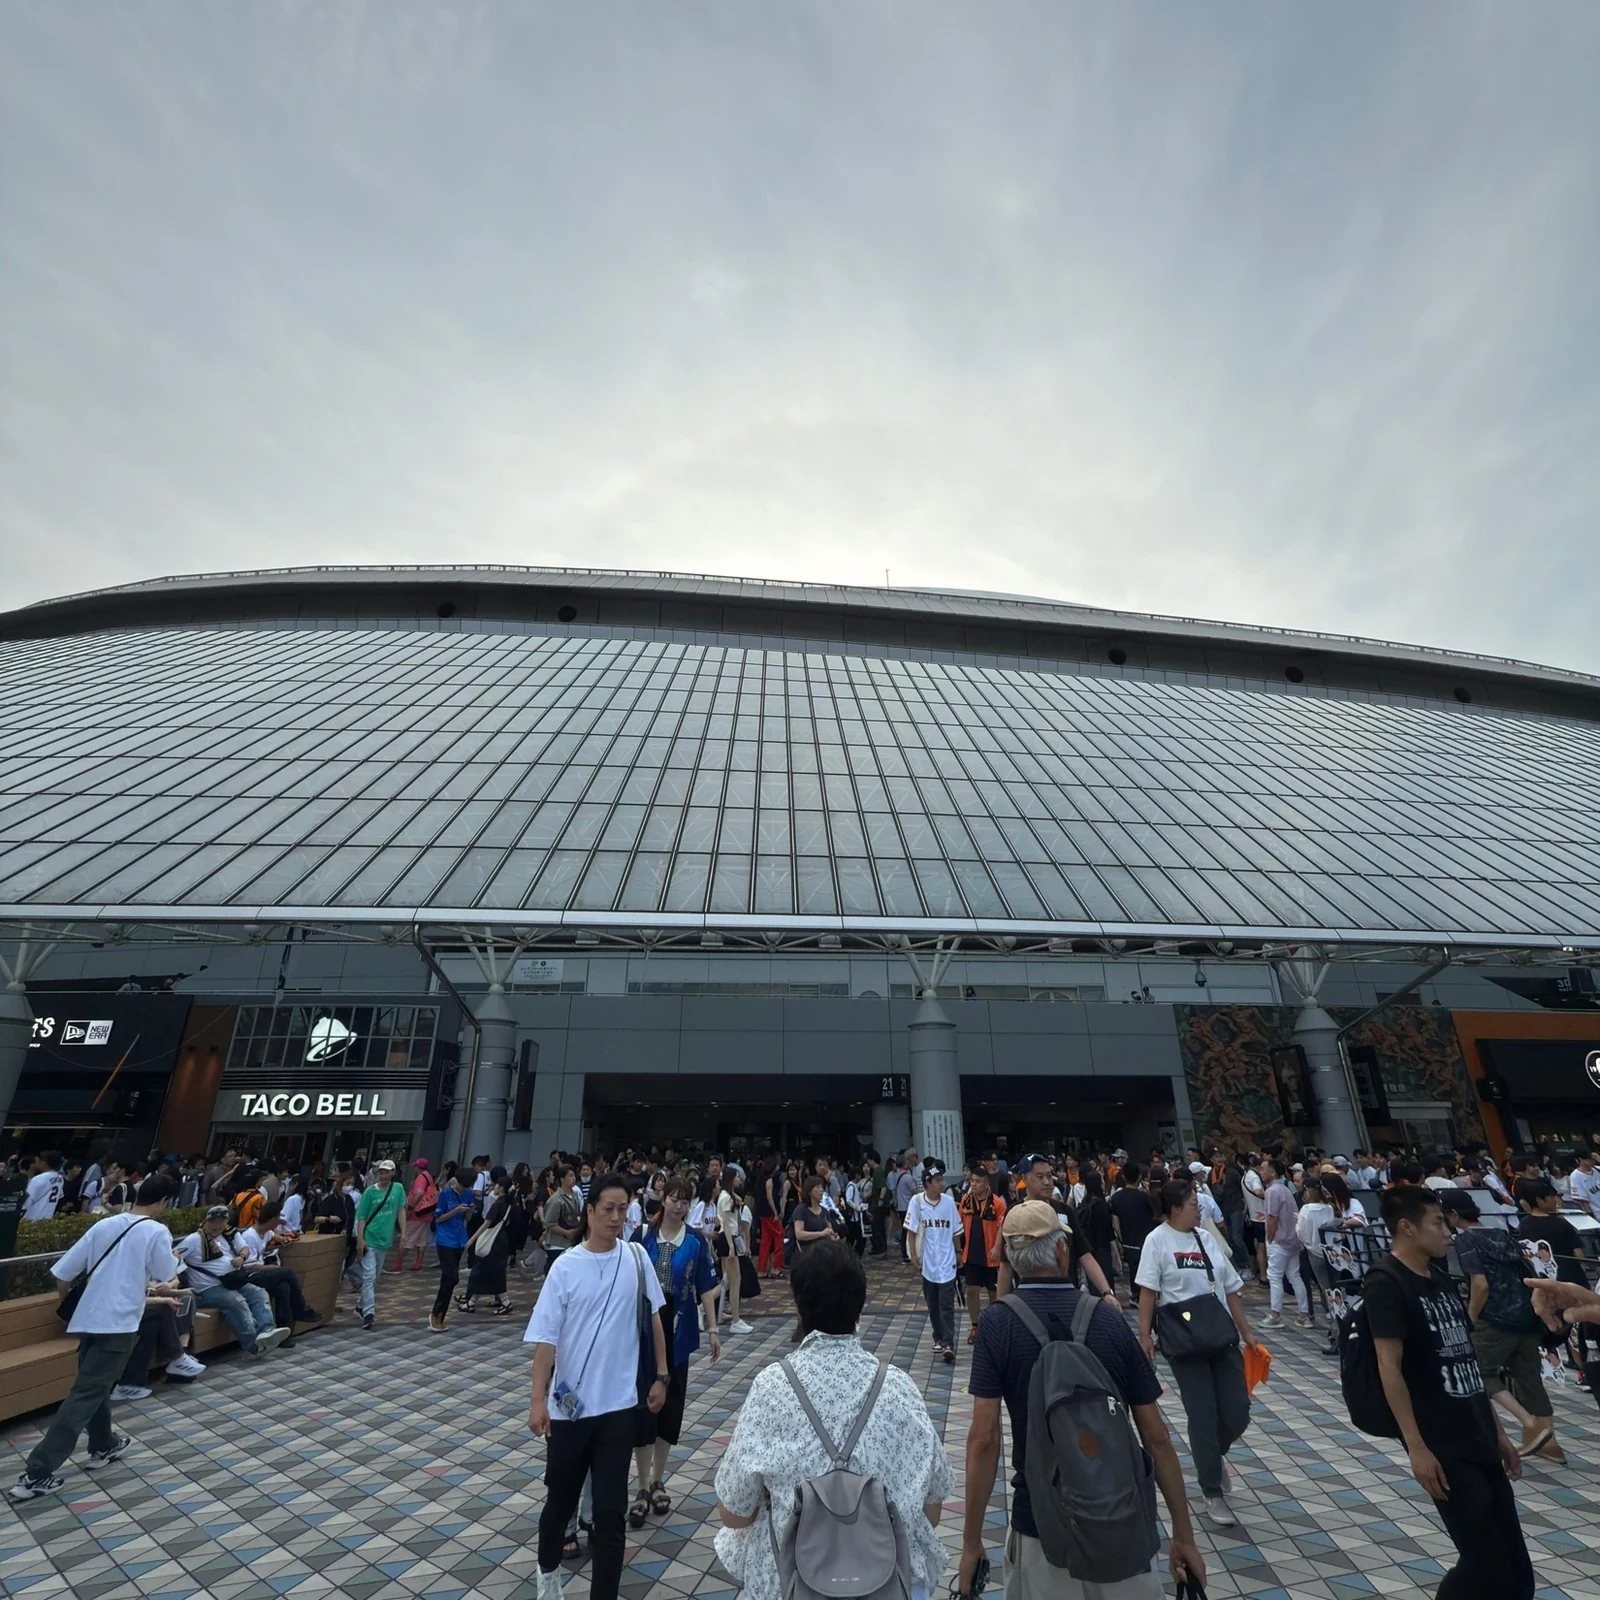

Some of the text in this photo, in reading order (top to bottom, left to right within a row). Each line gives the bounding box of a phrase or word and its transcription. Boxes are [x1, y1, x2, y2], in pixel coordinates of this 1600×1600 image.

[90, 1025, 110, 1033] NEW
[88, 1032, 108, 1040] ERA
[882, 1077, 893, 1090] 21
[240, 1093, 386, 1116] TACO BELL
